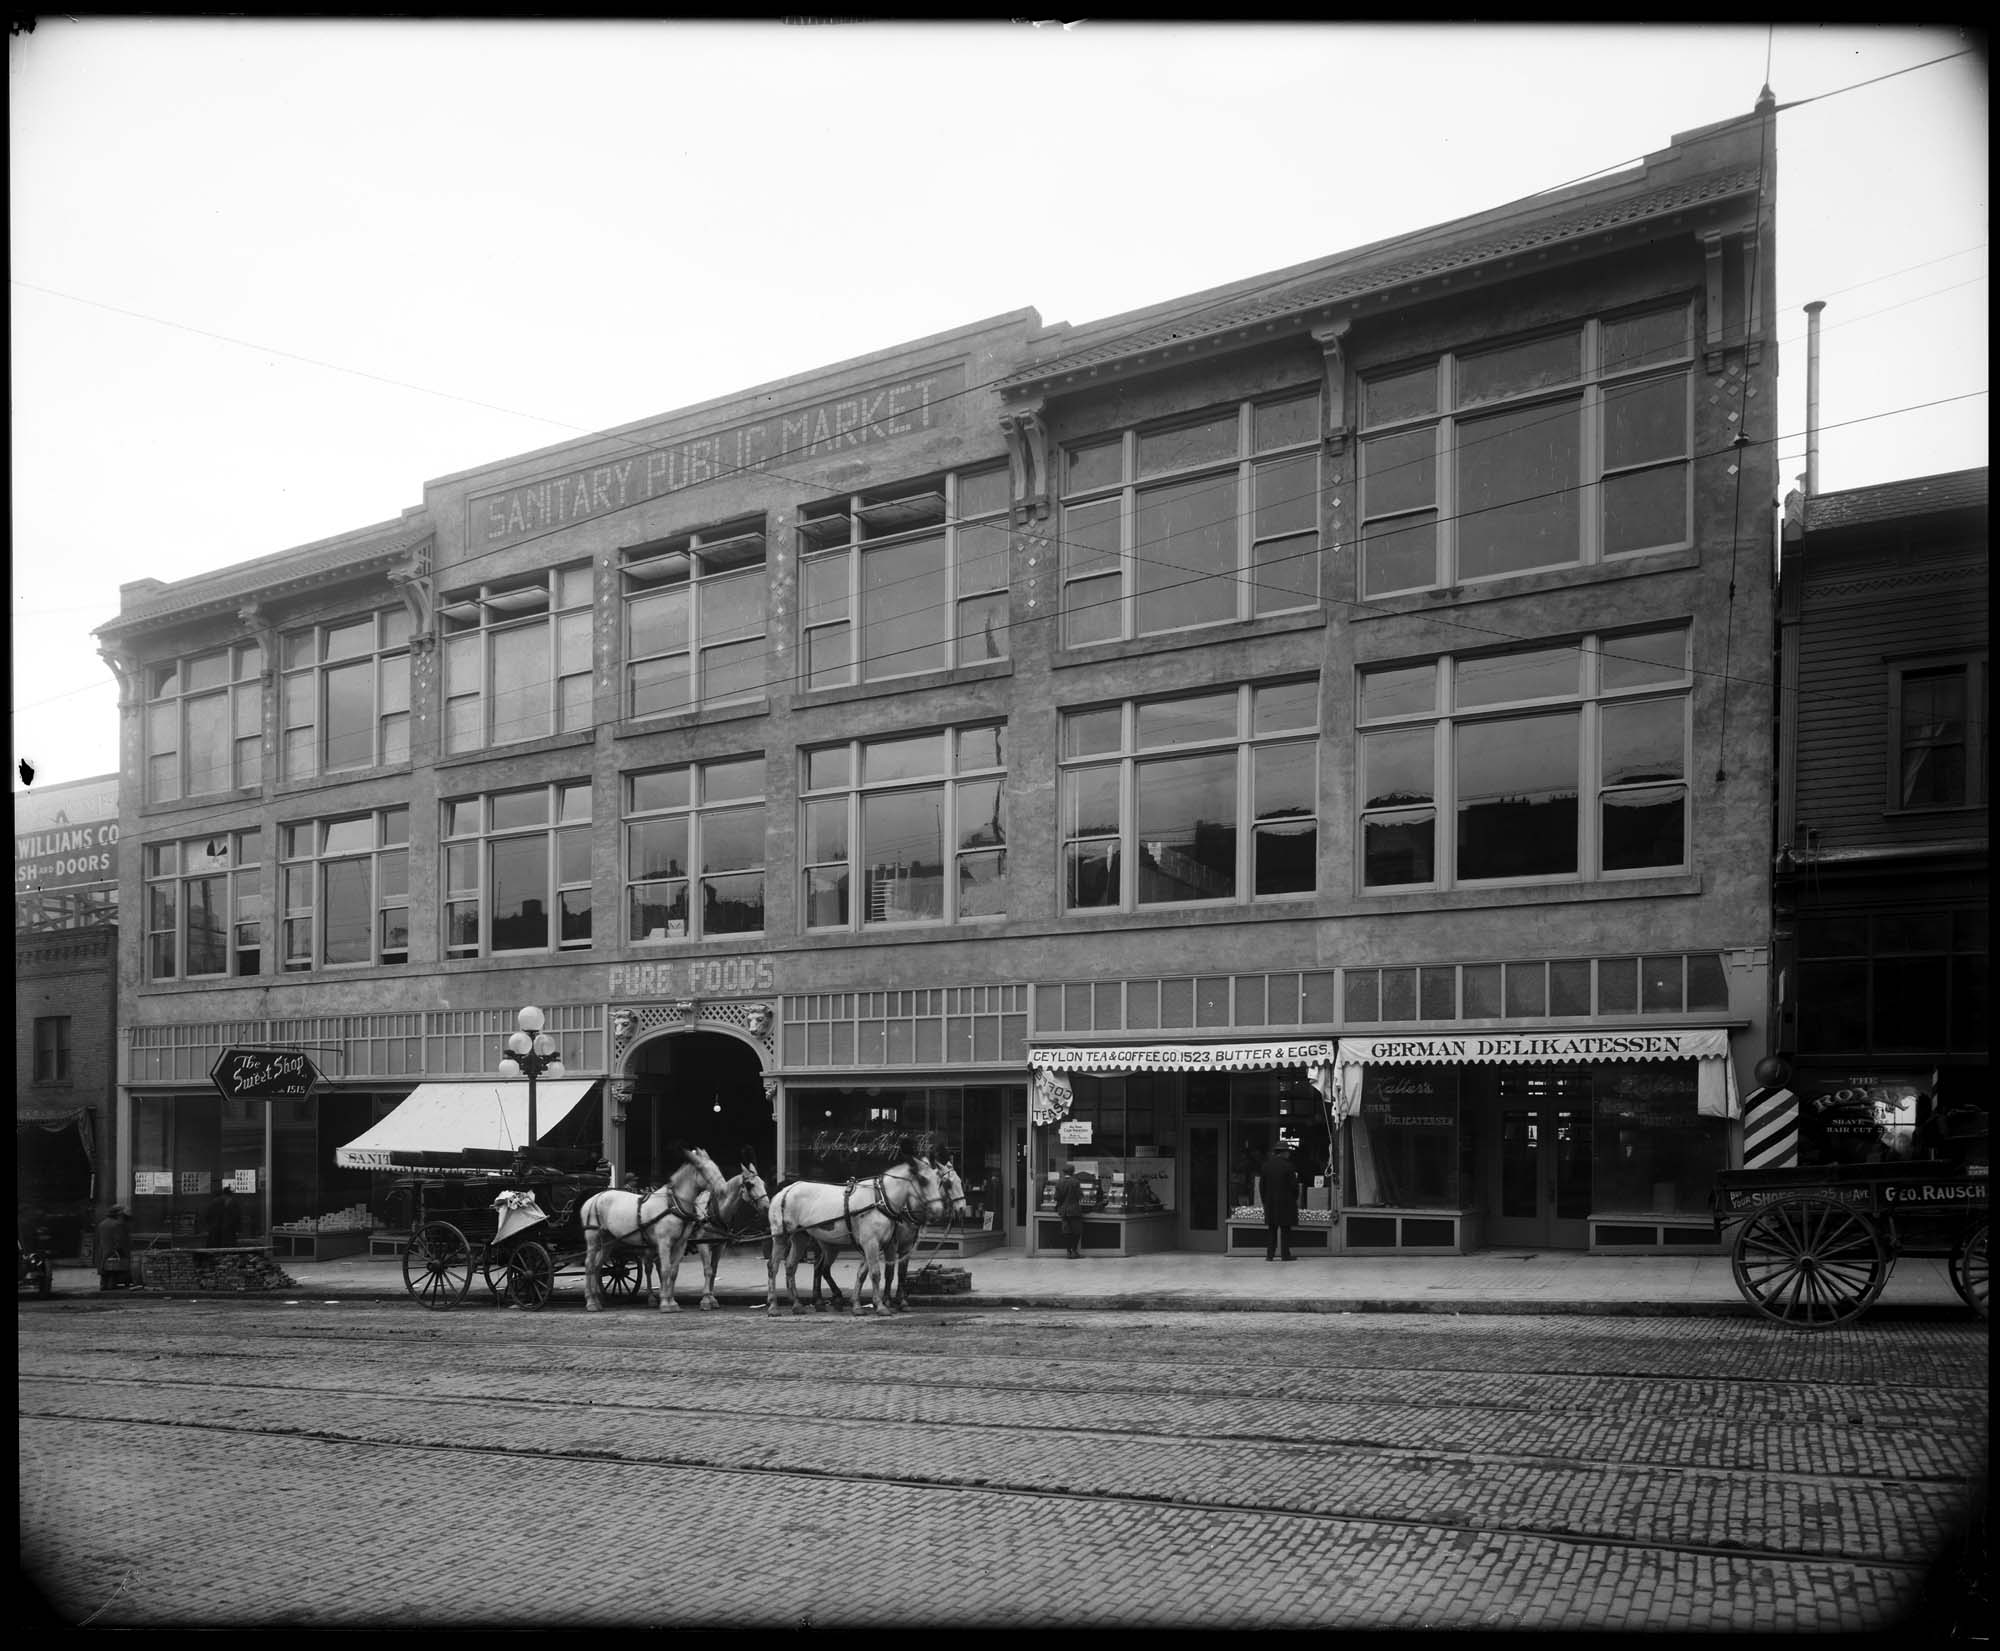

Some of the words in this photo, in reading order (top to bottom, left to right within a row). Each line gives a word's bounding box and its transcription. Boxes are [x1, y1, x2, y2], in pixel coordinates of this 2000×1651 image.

[487, 460, 633, 539] SANITARY
[646, 427, 767, 497] PUBLIC
[782, 376, 937, 457] MARKET
[17, 829, 92, 860] WILLIAMS
[17, 864, 37, 882] SH
[55, 853, 110, 876] DOORS
[608, 964, 673, 998] PURE
[689, 955, 776, 993] FOODS
[1033, 1052, 1082, 1062] CEYLON
[1215, 1048, 1271, 1062] BUTTER
[1275, 1047, 1285, 1058] &
[1371, 1041, 1467, 1058] GERMAN
[1477, 1036, 1682, 1056] DELIKATESSEN
[232, 1054, 262, 1070] The
[232, 1064, 273, 1094] Sweet
[273, 1055, 305, 1079] Shop
[1033, 1103, 1064, 1120] TEAS
[348, 1153, 391, 1165] SANIT
[1885, 1186, 1922, 1202] GEO.
[1922, 1184, 1985, 1201] RAUSCH
